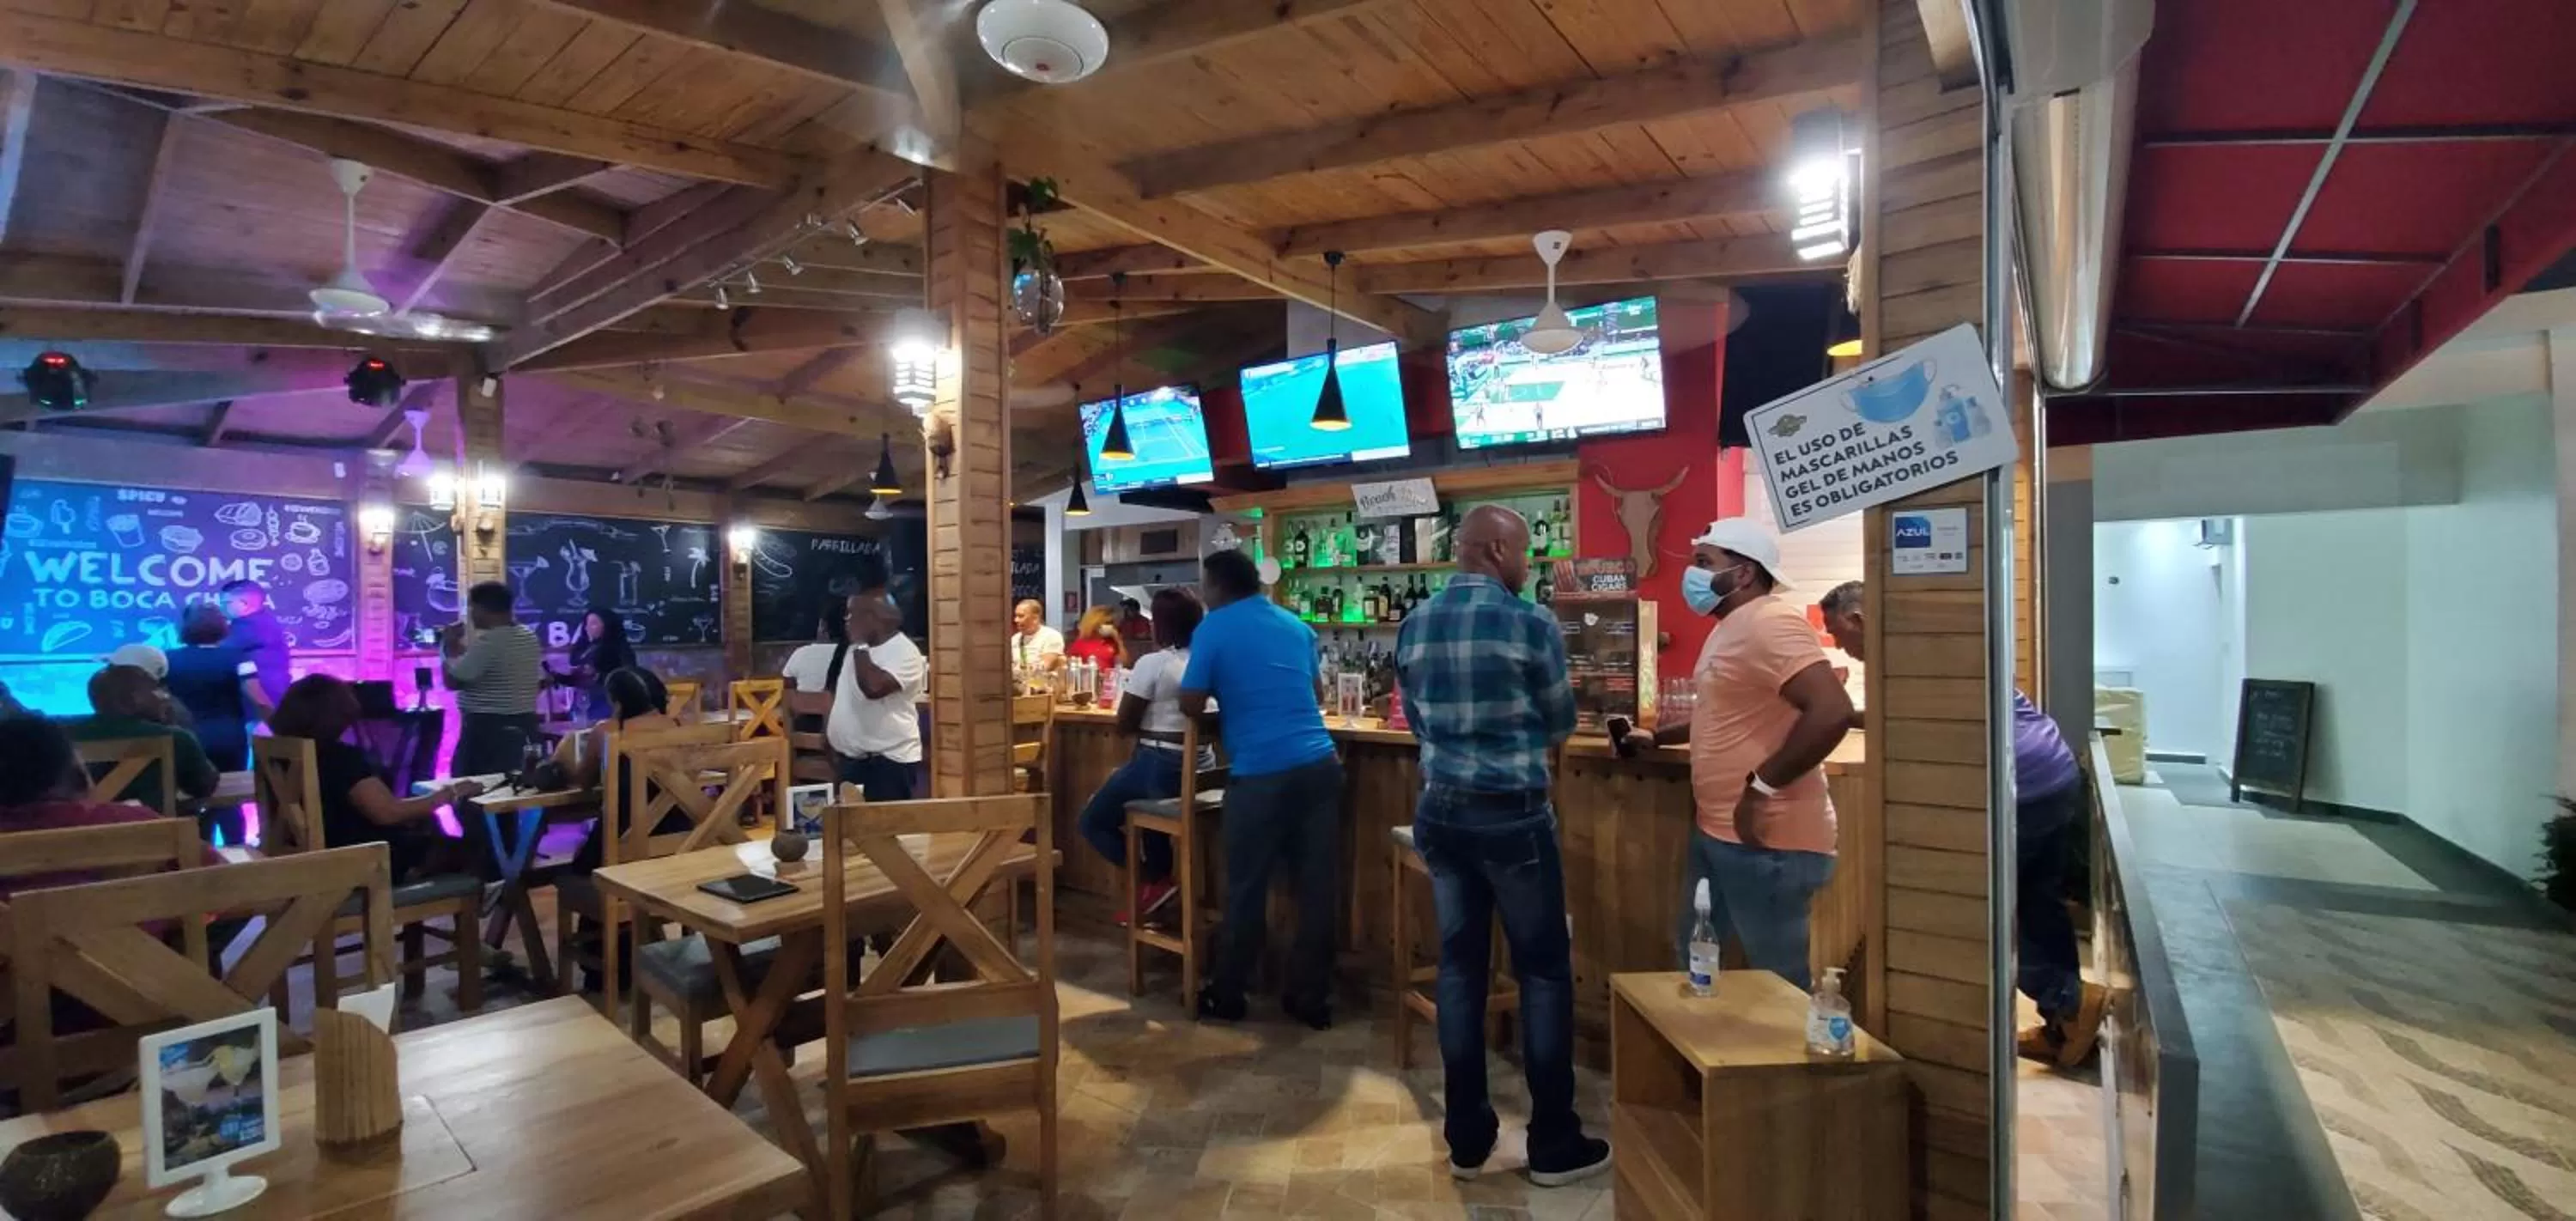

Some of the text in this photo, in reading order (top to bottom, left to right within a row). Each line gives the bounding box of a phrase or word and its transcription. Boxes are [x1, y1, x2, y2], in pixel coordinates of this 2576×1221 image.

[1775, 422, 1866, 465] EL USO DE
[1780, 425, 1913, 483] MASCARILLAS
[1786, 441, 1926, 499] GEL DE MANOS
[1790, 450, 1959, 517] ES OBLIGATORIOS
[1896, 528, 1929, 537] AZUL
[24, 550, 274, 588] WELCOME
[33, 588, 276, 610] TO BOCA CHA
